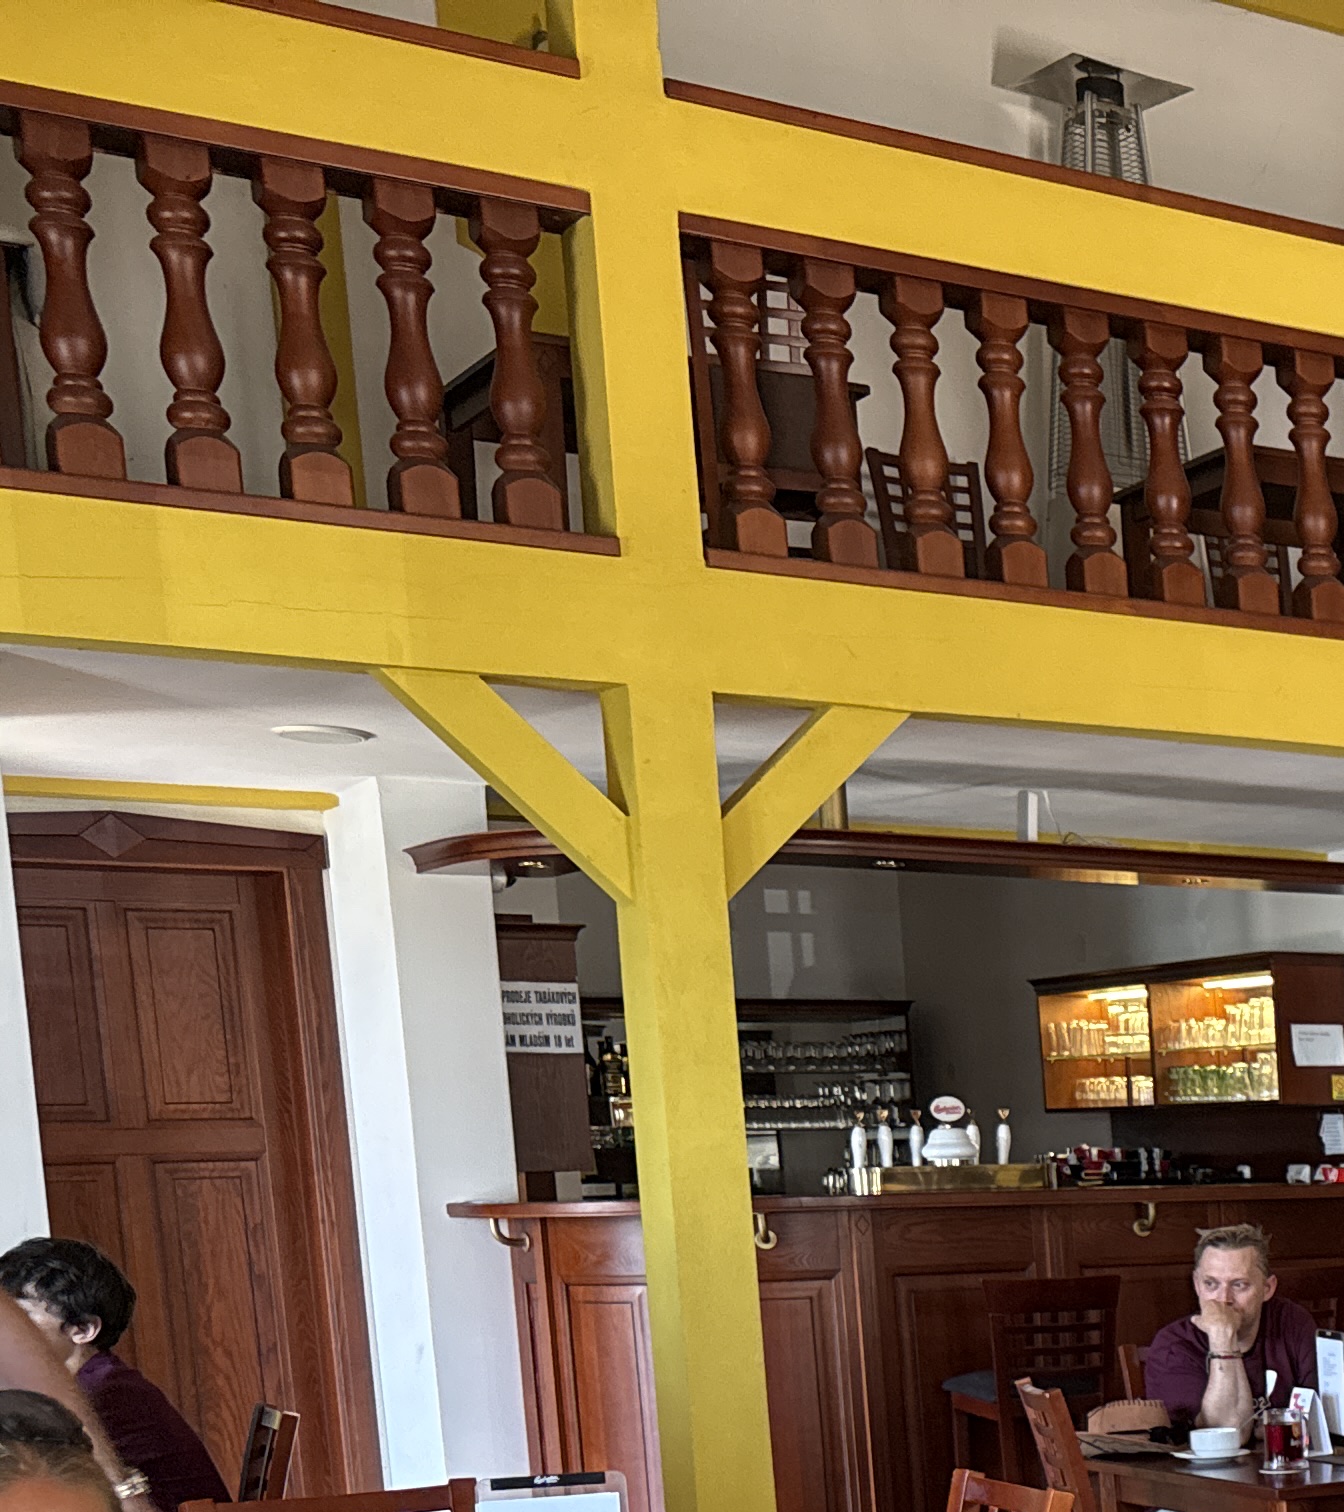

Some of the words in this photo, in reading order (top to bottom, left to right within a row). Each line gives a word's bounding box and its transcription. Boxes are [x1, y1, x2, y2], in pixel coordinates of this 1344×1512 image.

[501, 990, 532, 1004] PRODEJE
[553, 1034, 562, 1049] 18
[564, 1034, 575, 1049] let
